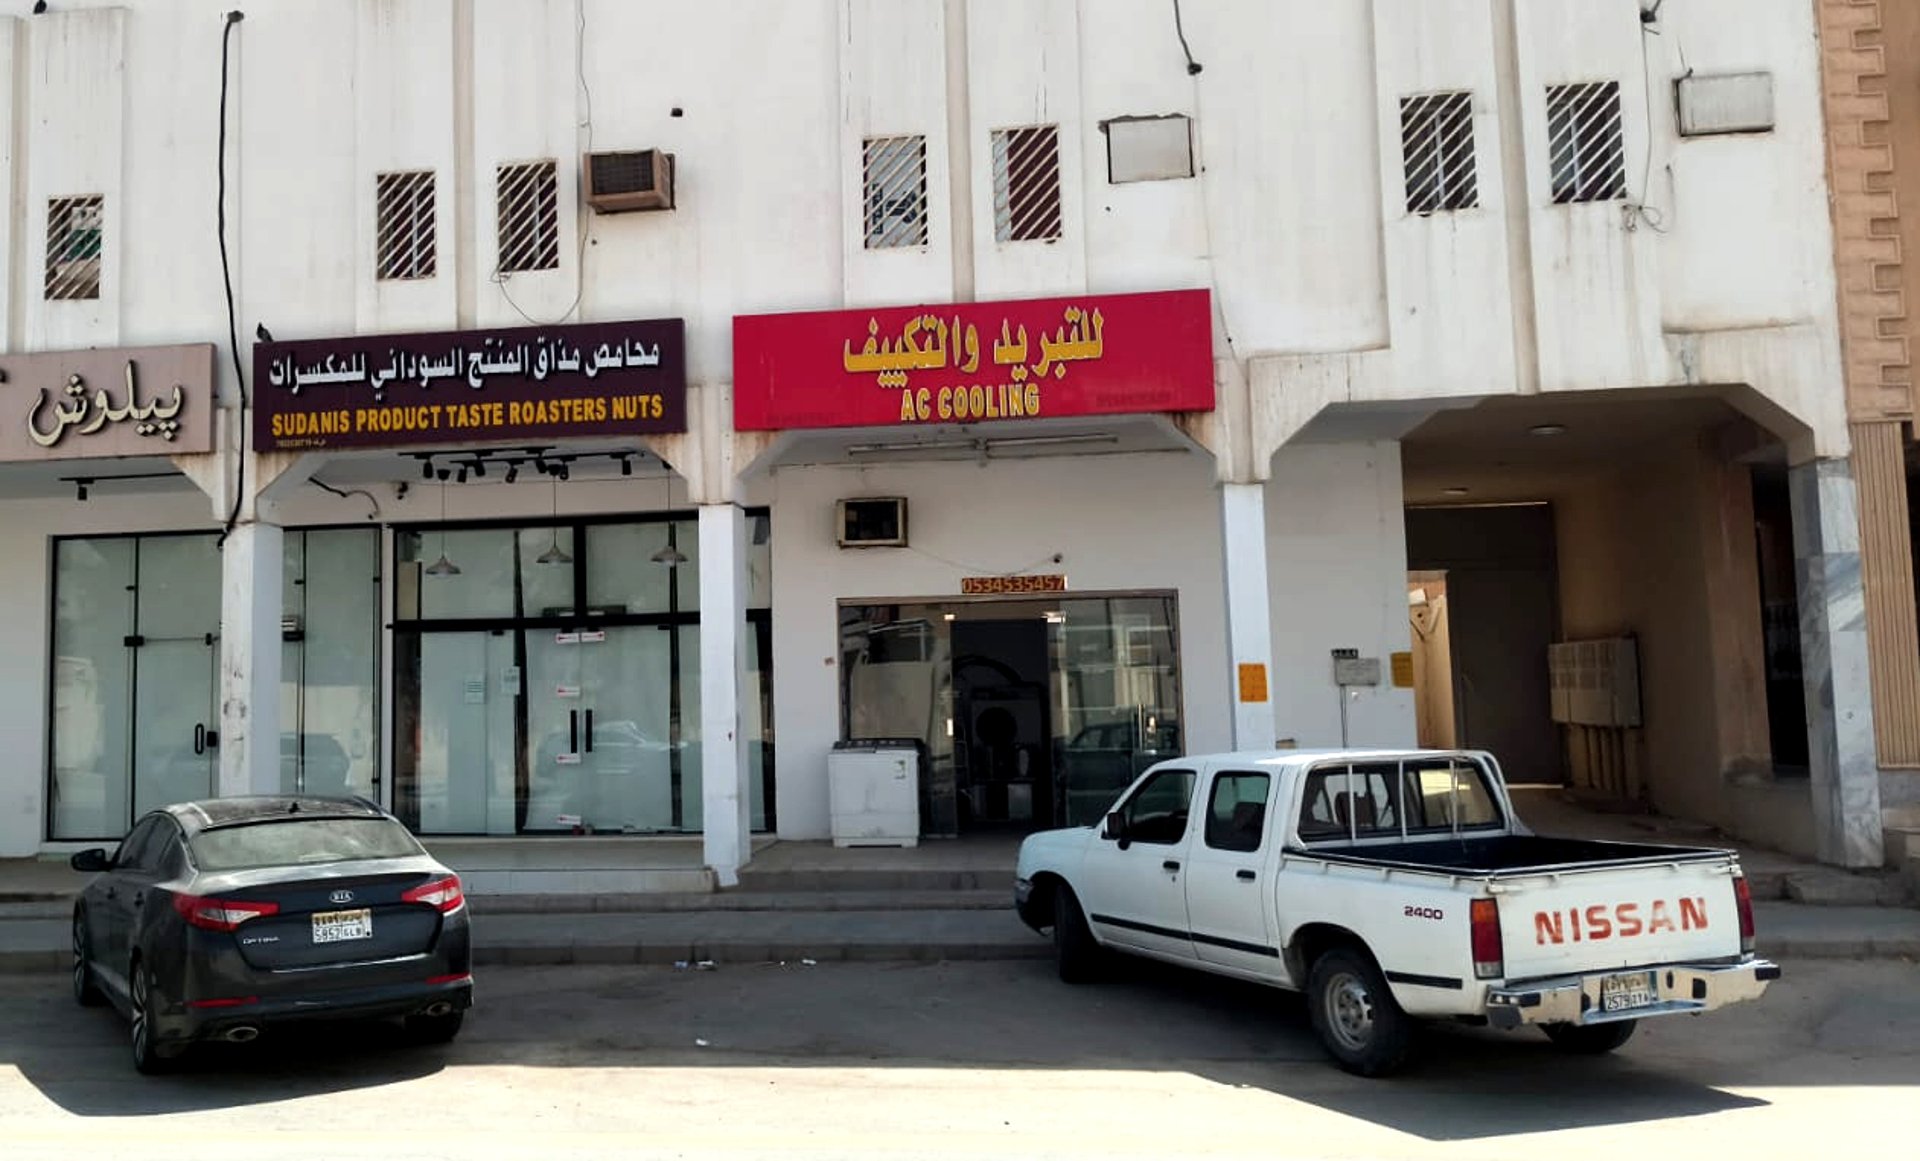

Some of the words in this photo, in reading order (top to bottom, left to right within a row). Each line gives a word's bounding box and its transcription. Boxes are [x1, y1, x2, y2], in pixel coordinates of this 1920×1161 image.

[467, 337, 529, 388] المنتج
[533, 336, 580, 380] مذاق
[585, 337, 660, 377] محامص
[843, 314, 980, 388] والتكييف
[994, 306, 1104, 382] للتبريد
[269, 351, 366, 395] للمكسرات
[370, 346, 463, 402] السوداني
[271, 410, 351, 437] SUDANIS
[356, 404, 441, 432] PRODUCT
[446, 401, 504, 428] TASTE
[509, 396, 607, 425] ROASTERS
[612, 393, 664, 419] NUTS
[901, 387, 931, 420] AC
[937, 382, 1039, 418] COOLING
[1404, 905, 1443, 920] 2400
[1534, 897, 1709, 946] NISSAN
